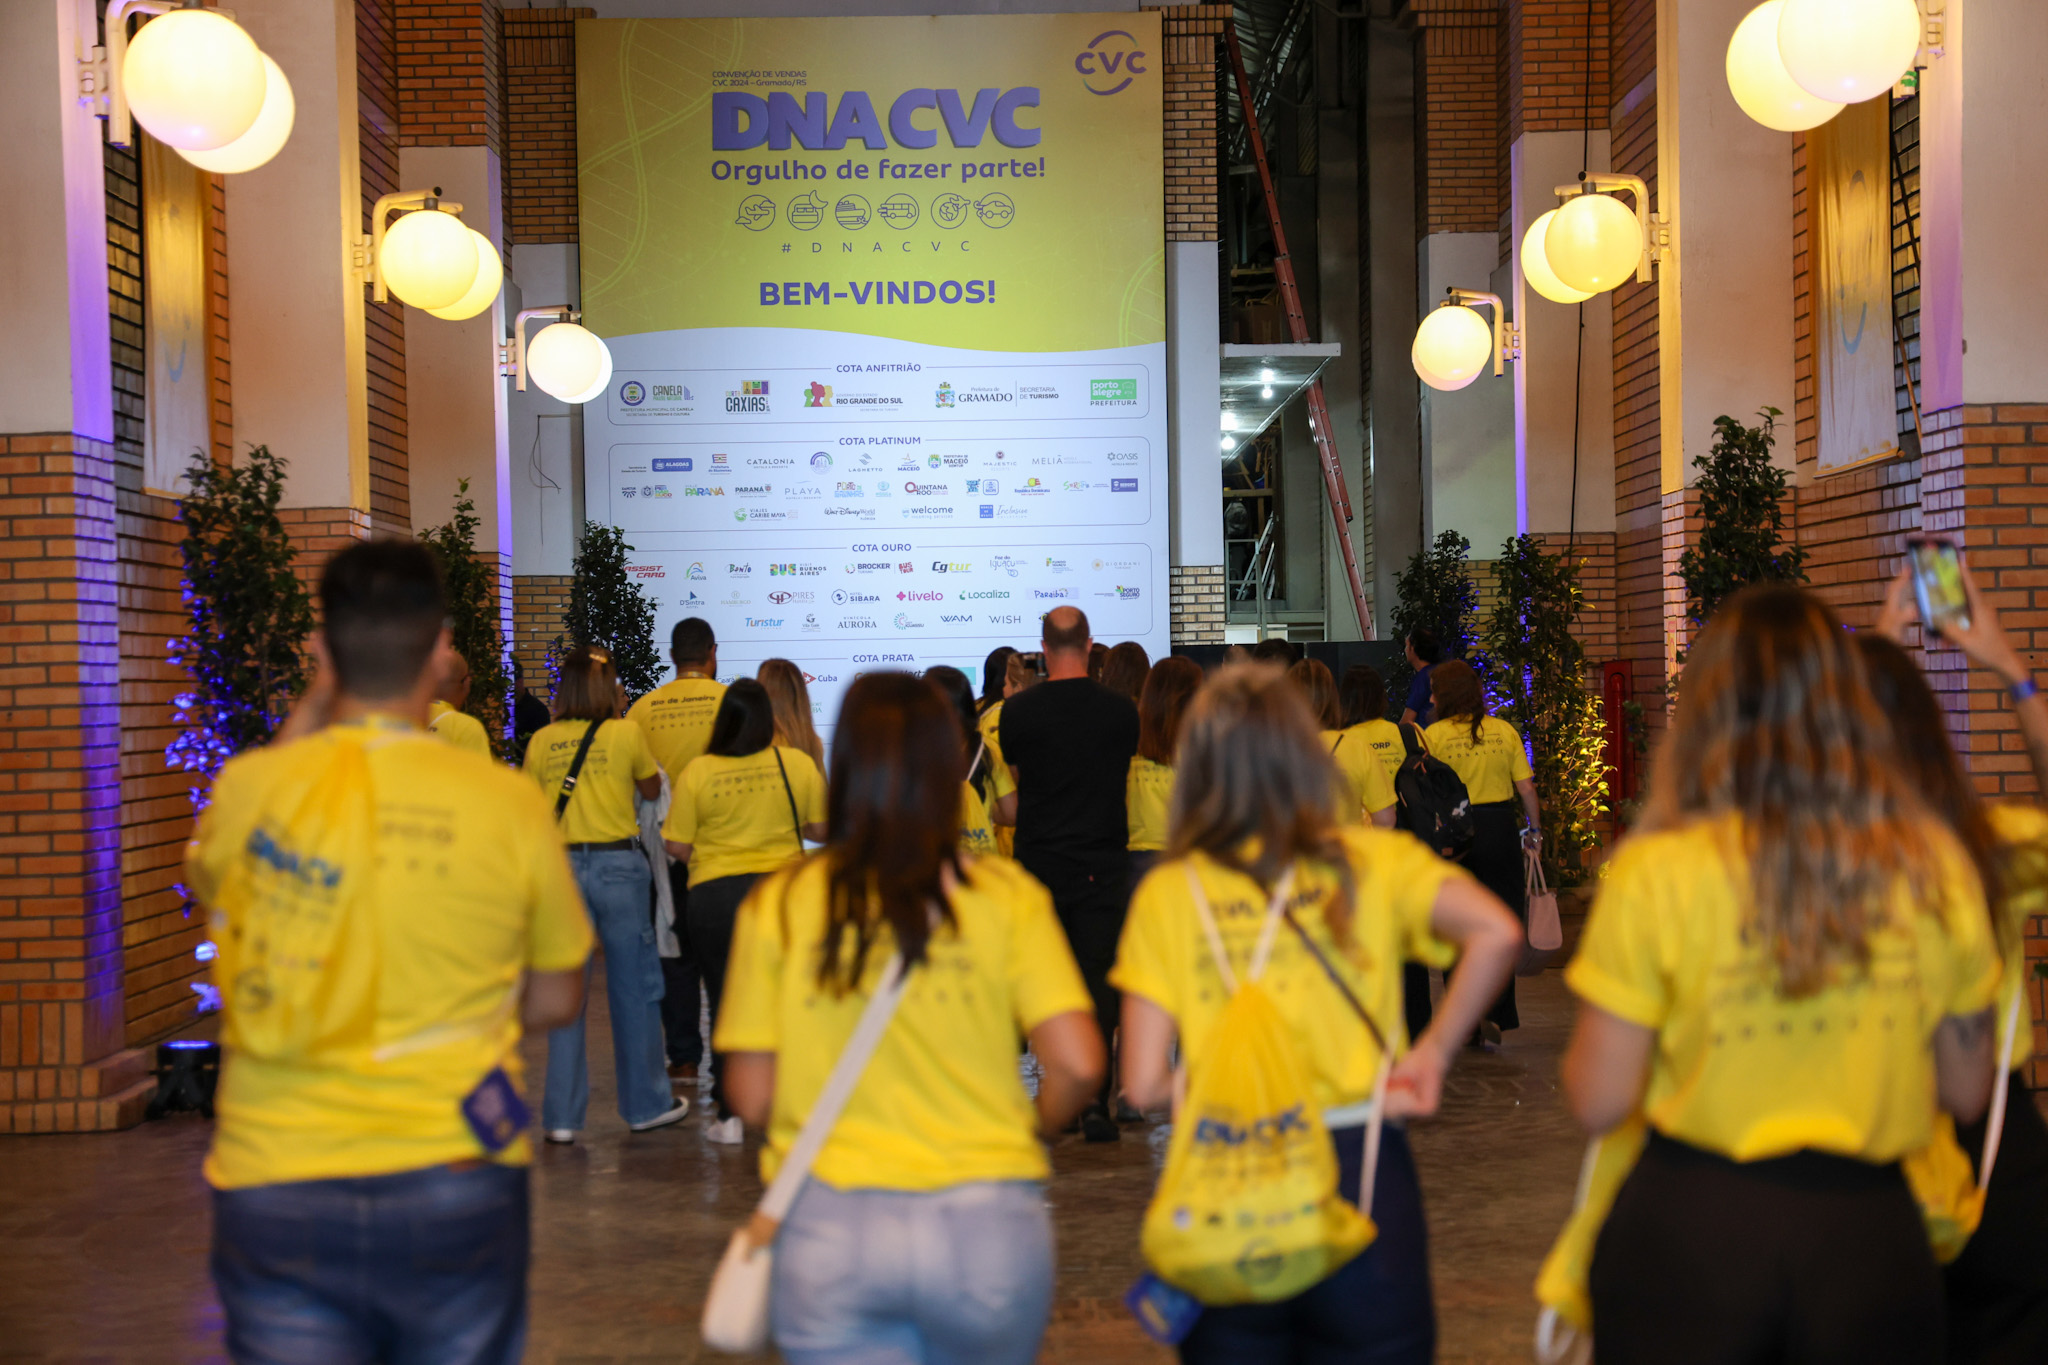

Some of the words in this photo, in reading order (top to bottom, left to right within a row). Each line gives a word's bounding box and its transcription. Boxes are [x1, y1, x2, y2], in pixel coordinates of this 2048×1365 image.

[1075, 51, 1147, 75] CVC
[712, 70, 760, 79] CONVENÇÃO
[774, 70, 807, 78] VENDAS
[712, 79, 728, 87] CVC
[729, 79, 749, 87] 2024
[756, 79, 807, 87] Gramado/RS
[712, 91, 888, 151] DNA
[888, 87, 1041, 150] CVC
[711, 160, 827, 185] Orgulho
[836, 159, 870, 179] de
[878, 158, 952, 179] fazer
[961, 157, 1045, 183] parte!
[759, 279, 996, 306] BEM-VINDOS!
[836, 364, 863, 373] COTA
[865, 362, 922, 373] ANFITRIÃO
[652, 385, 682, 396] CANELA
[1092, 381, 1119, 390] porto
[958, 392, 1013, 402] GRAMADO
[1092, 388, 1122, 398] alegre
[725, 396, 765, 412] CAXIAS
[838, 437, 866, 446] COTA
[868, 436, 921, 445] PLATINUM
[1116, 452, 1138, 460] OASIS
[685, 486, 725, 496] PARANÁ
[905, 481, 948, 494] QUINTANA
[911, 505, 954, 514] welcome
[996, 505, 1028, 515] Inclusive
[852, 544, 879, 552] COTA
[881, 543, 912, 552] OURO
[857, 562, 891, 570] BROCKER
[792, 591, 815, 599] PIRES
[908, 590, 944, 601] livelo
[745, 617, 785, 627] Turistur
[837, 620, 877, 629] AURORA
[988, 615, 1022, 624] WISH
[852, 654, 879, 663] COTA
[882, 653, 915, 662] PRATA
[650, 699, 665, 707] Rio
[681, 694, 716, 703] Janeiro
